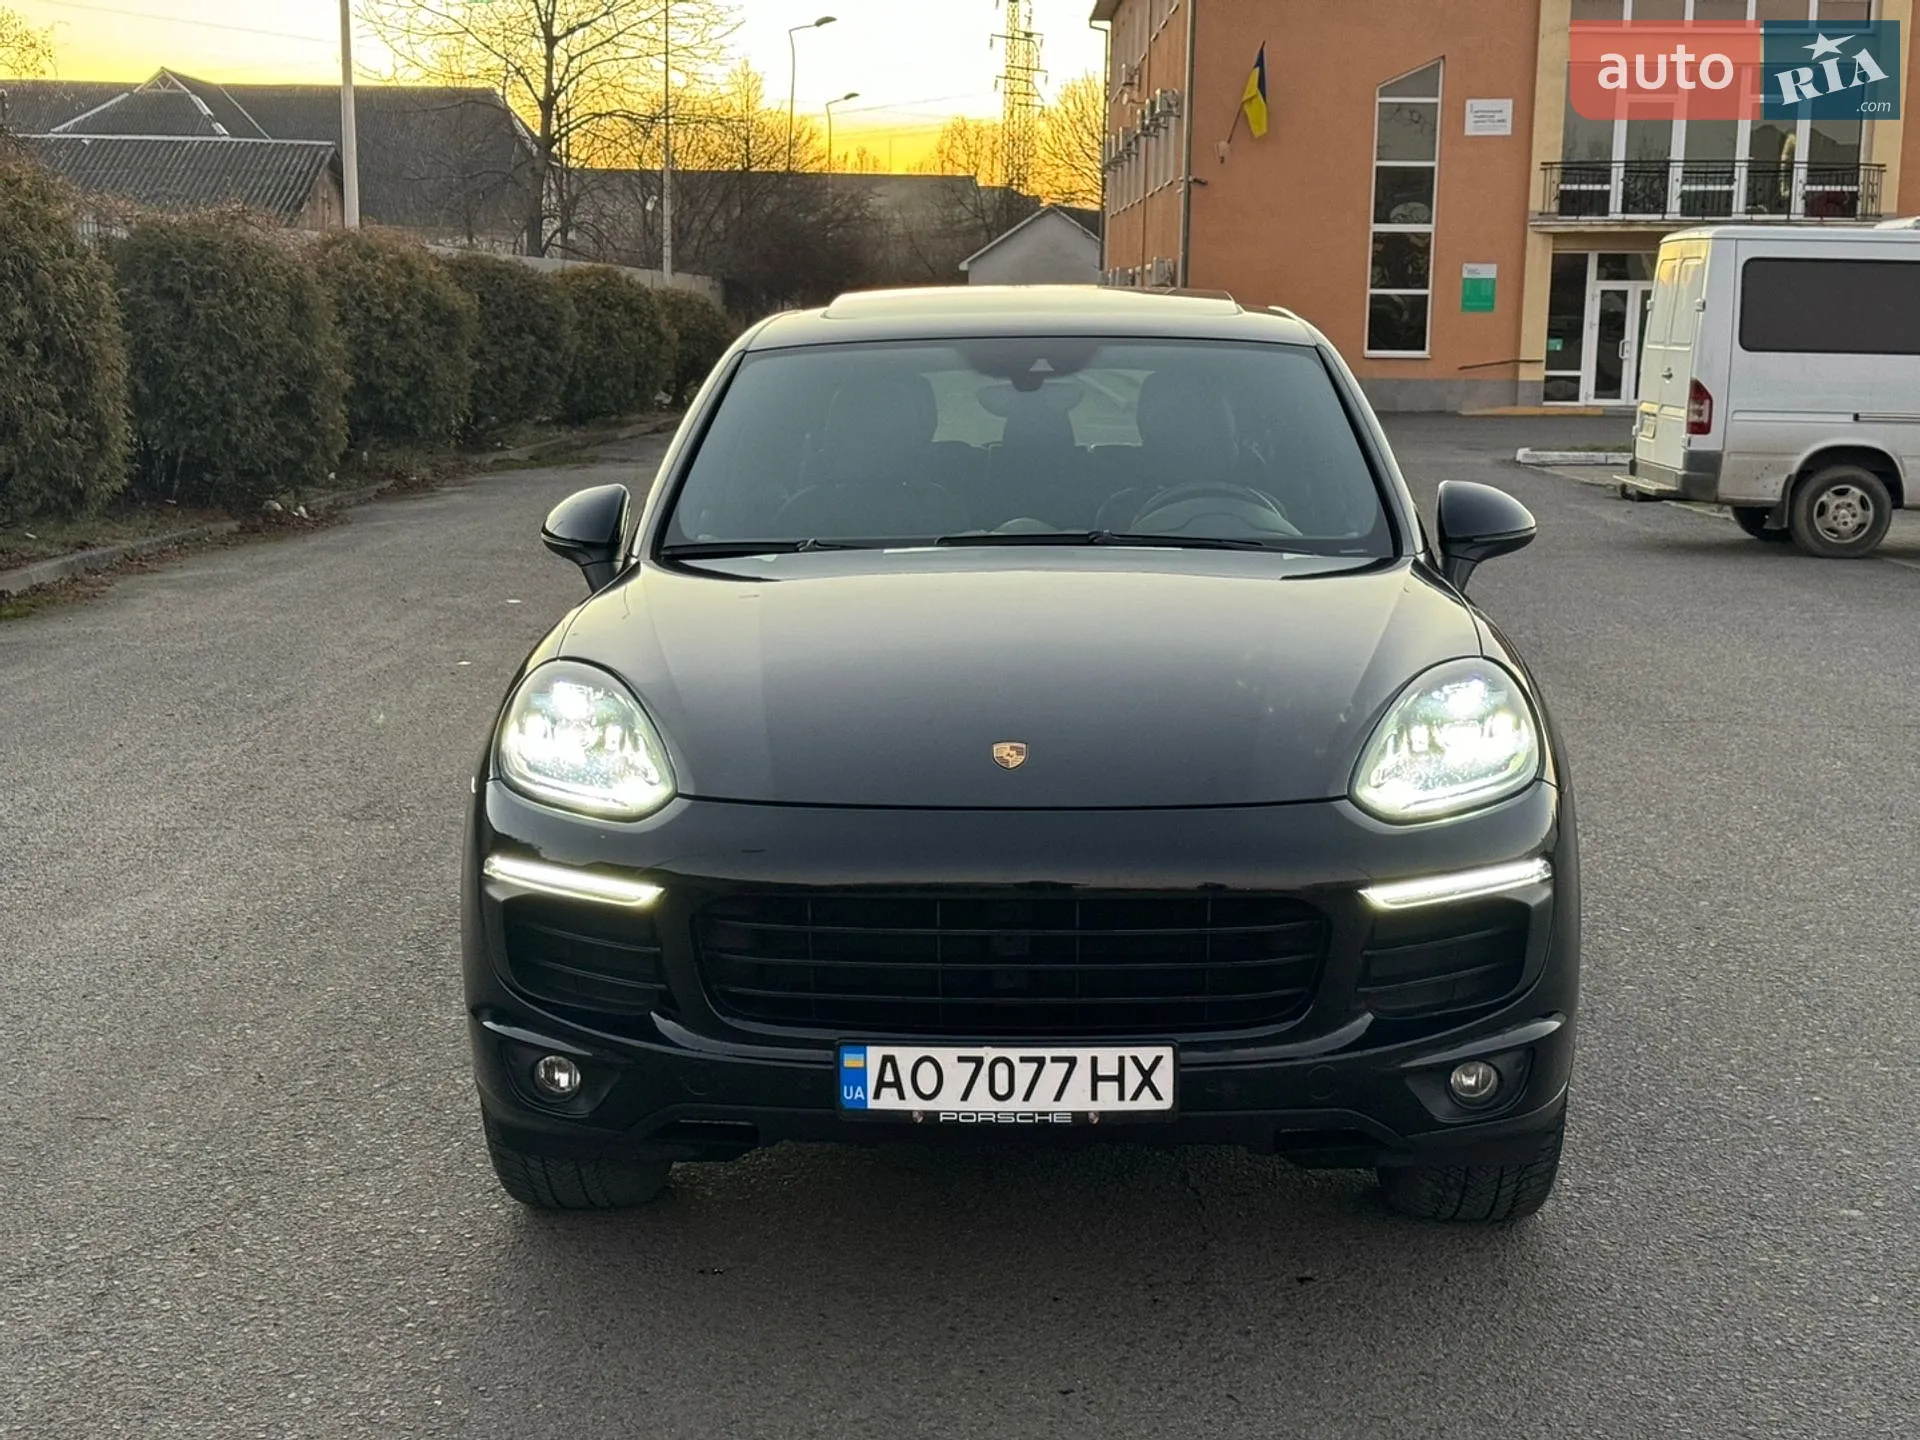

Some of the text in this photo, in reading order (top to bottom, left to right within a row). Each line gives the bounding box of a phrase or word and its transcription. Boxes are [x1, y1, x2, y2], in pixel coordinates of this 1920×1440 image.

[872, 1054, 1164, 1102] AO 7077 HX
[843, 1086, 865, 1100] UA
[939, 1112, 1073, 1124] PORSCHE
